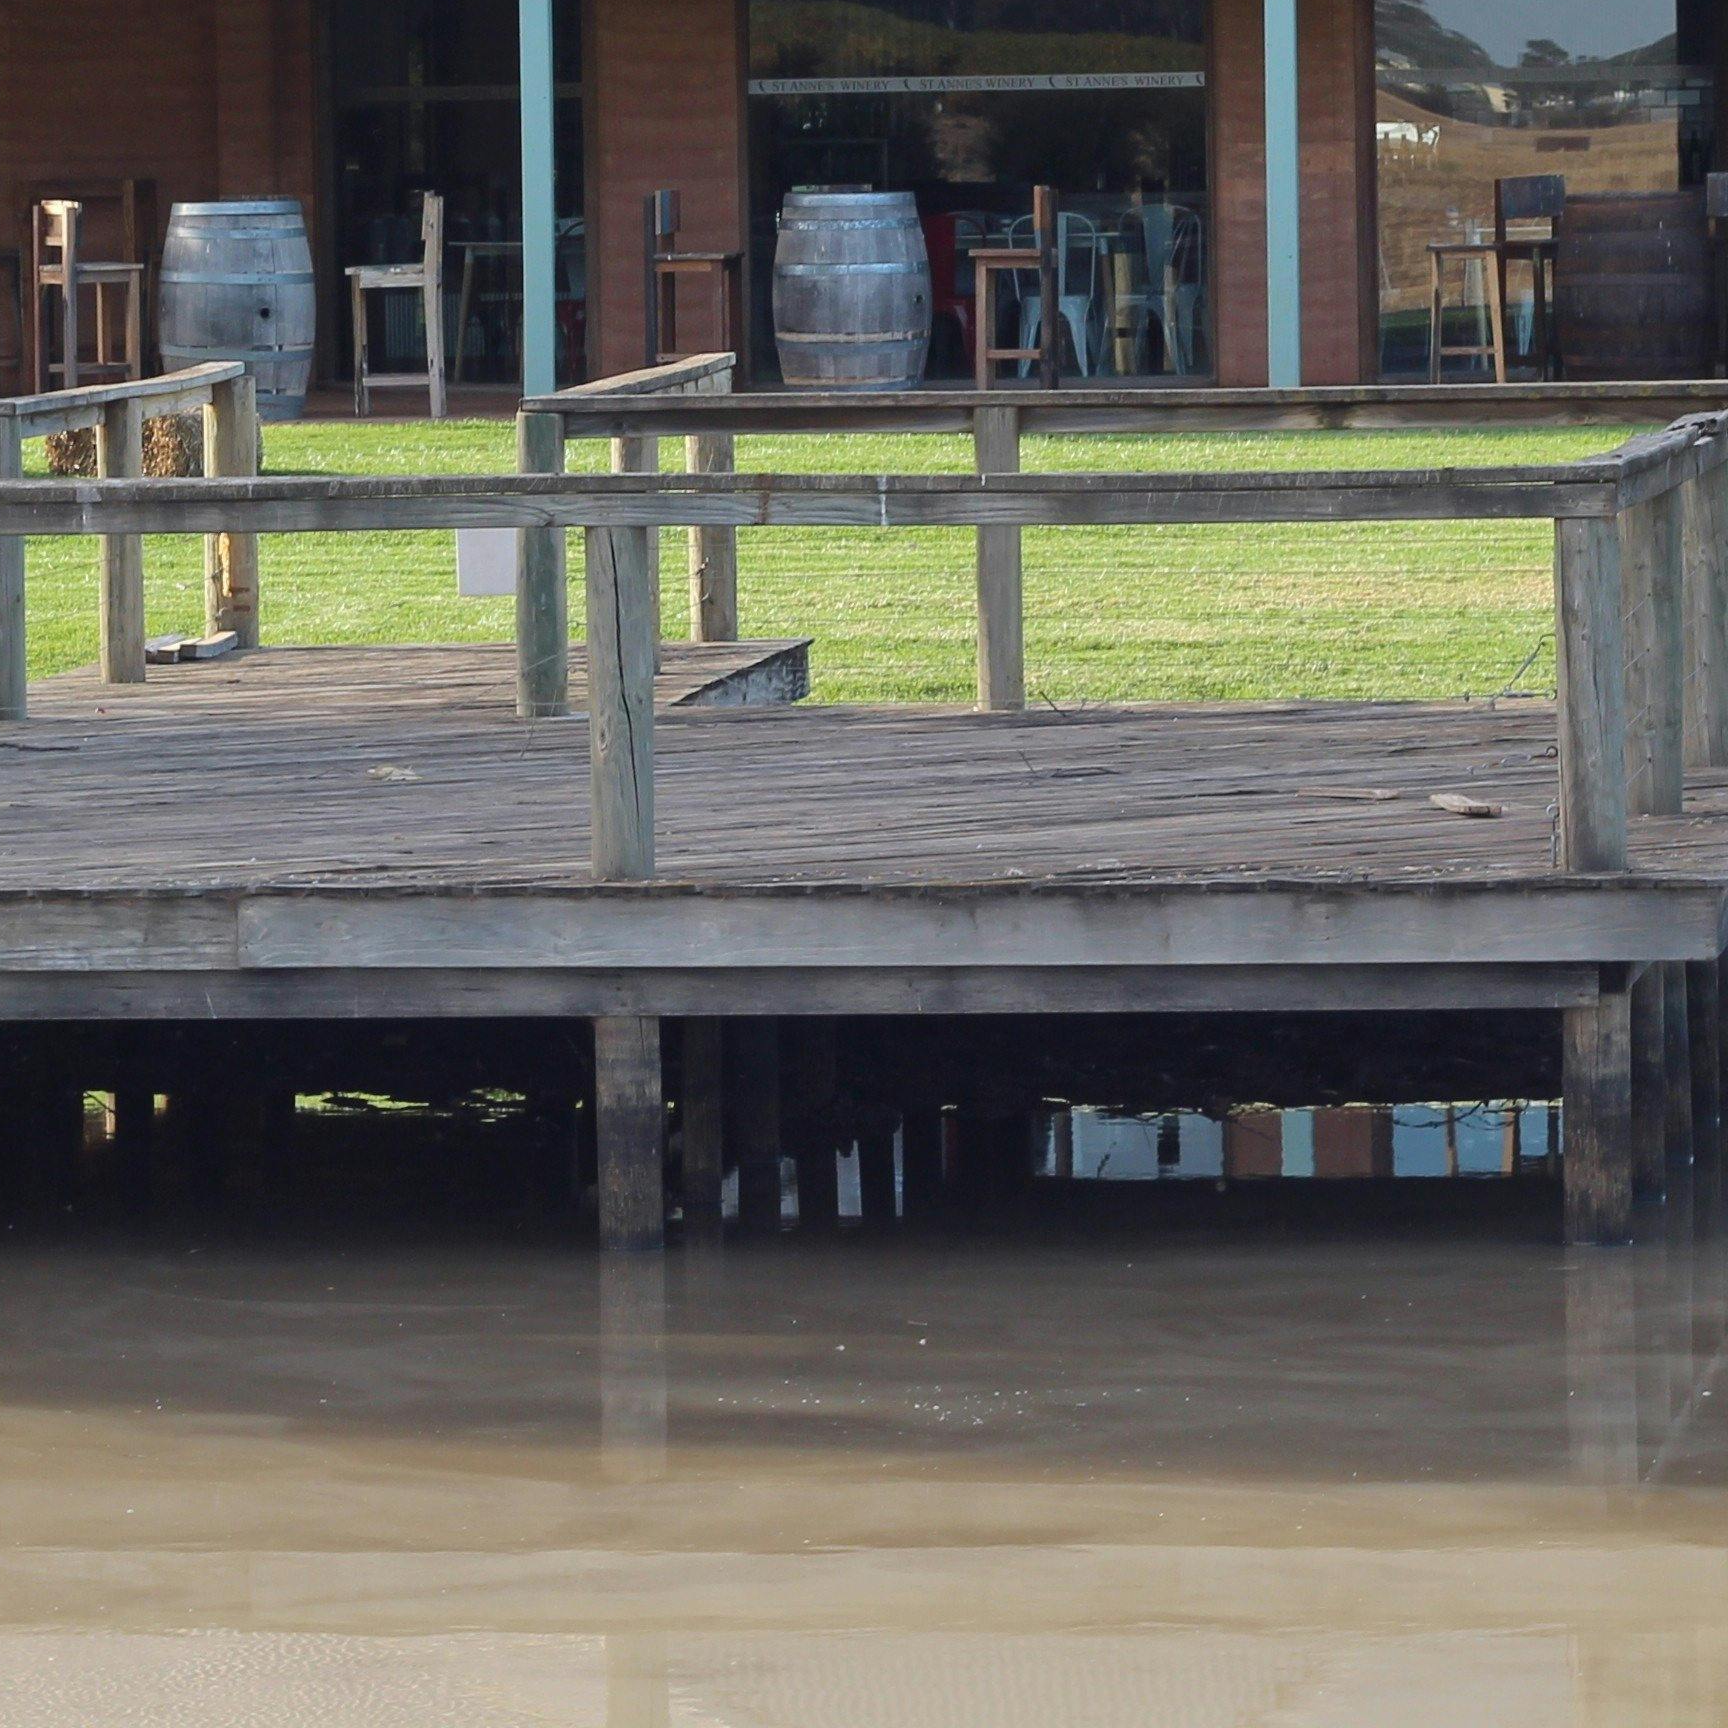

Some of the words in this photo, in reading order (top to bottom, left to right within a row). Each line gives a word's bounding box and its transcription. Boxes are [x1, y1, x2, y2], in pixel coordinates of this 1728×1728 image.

[772, 79, 786, 91] ST
[790, 79, 835, 91] ANNE'S
[839, 78, 890, 90] WINERY
[919, 78, 934, 90] ST
[986, 77, 1035, 89] WINERY
[1065, 76, 1079, 88] ST
[1084, 75, 1129, 87] ANNE'S
[1133, 74, 1184, 86] WINERY
